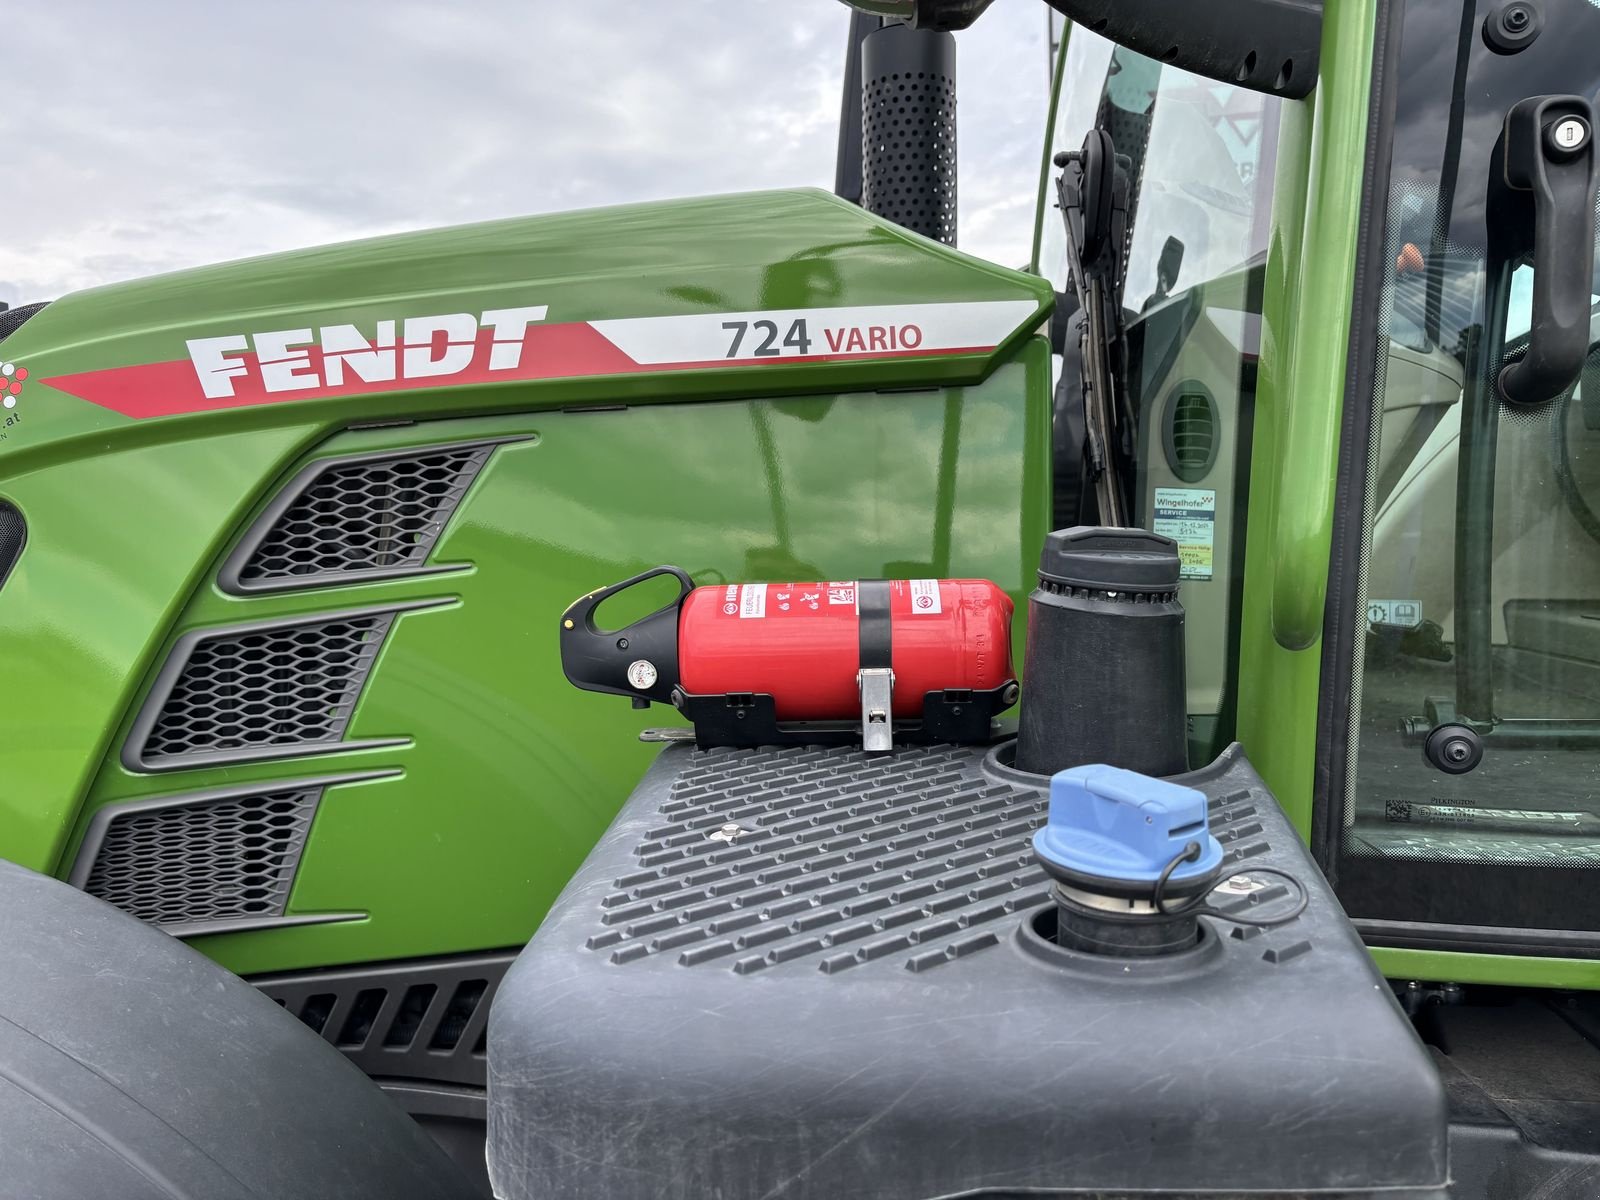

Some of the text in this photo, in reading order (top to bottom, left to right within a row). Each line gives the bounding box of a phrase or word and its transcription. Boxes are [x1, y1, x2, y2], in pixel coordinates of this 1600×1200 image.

[185, 304, 549, 399] FENDT
[722, 318, 922, 358] 724 VARIO
[1156, 498, 1205, 508] Wingelhofer
